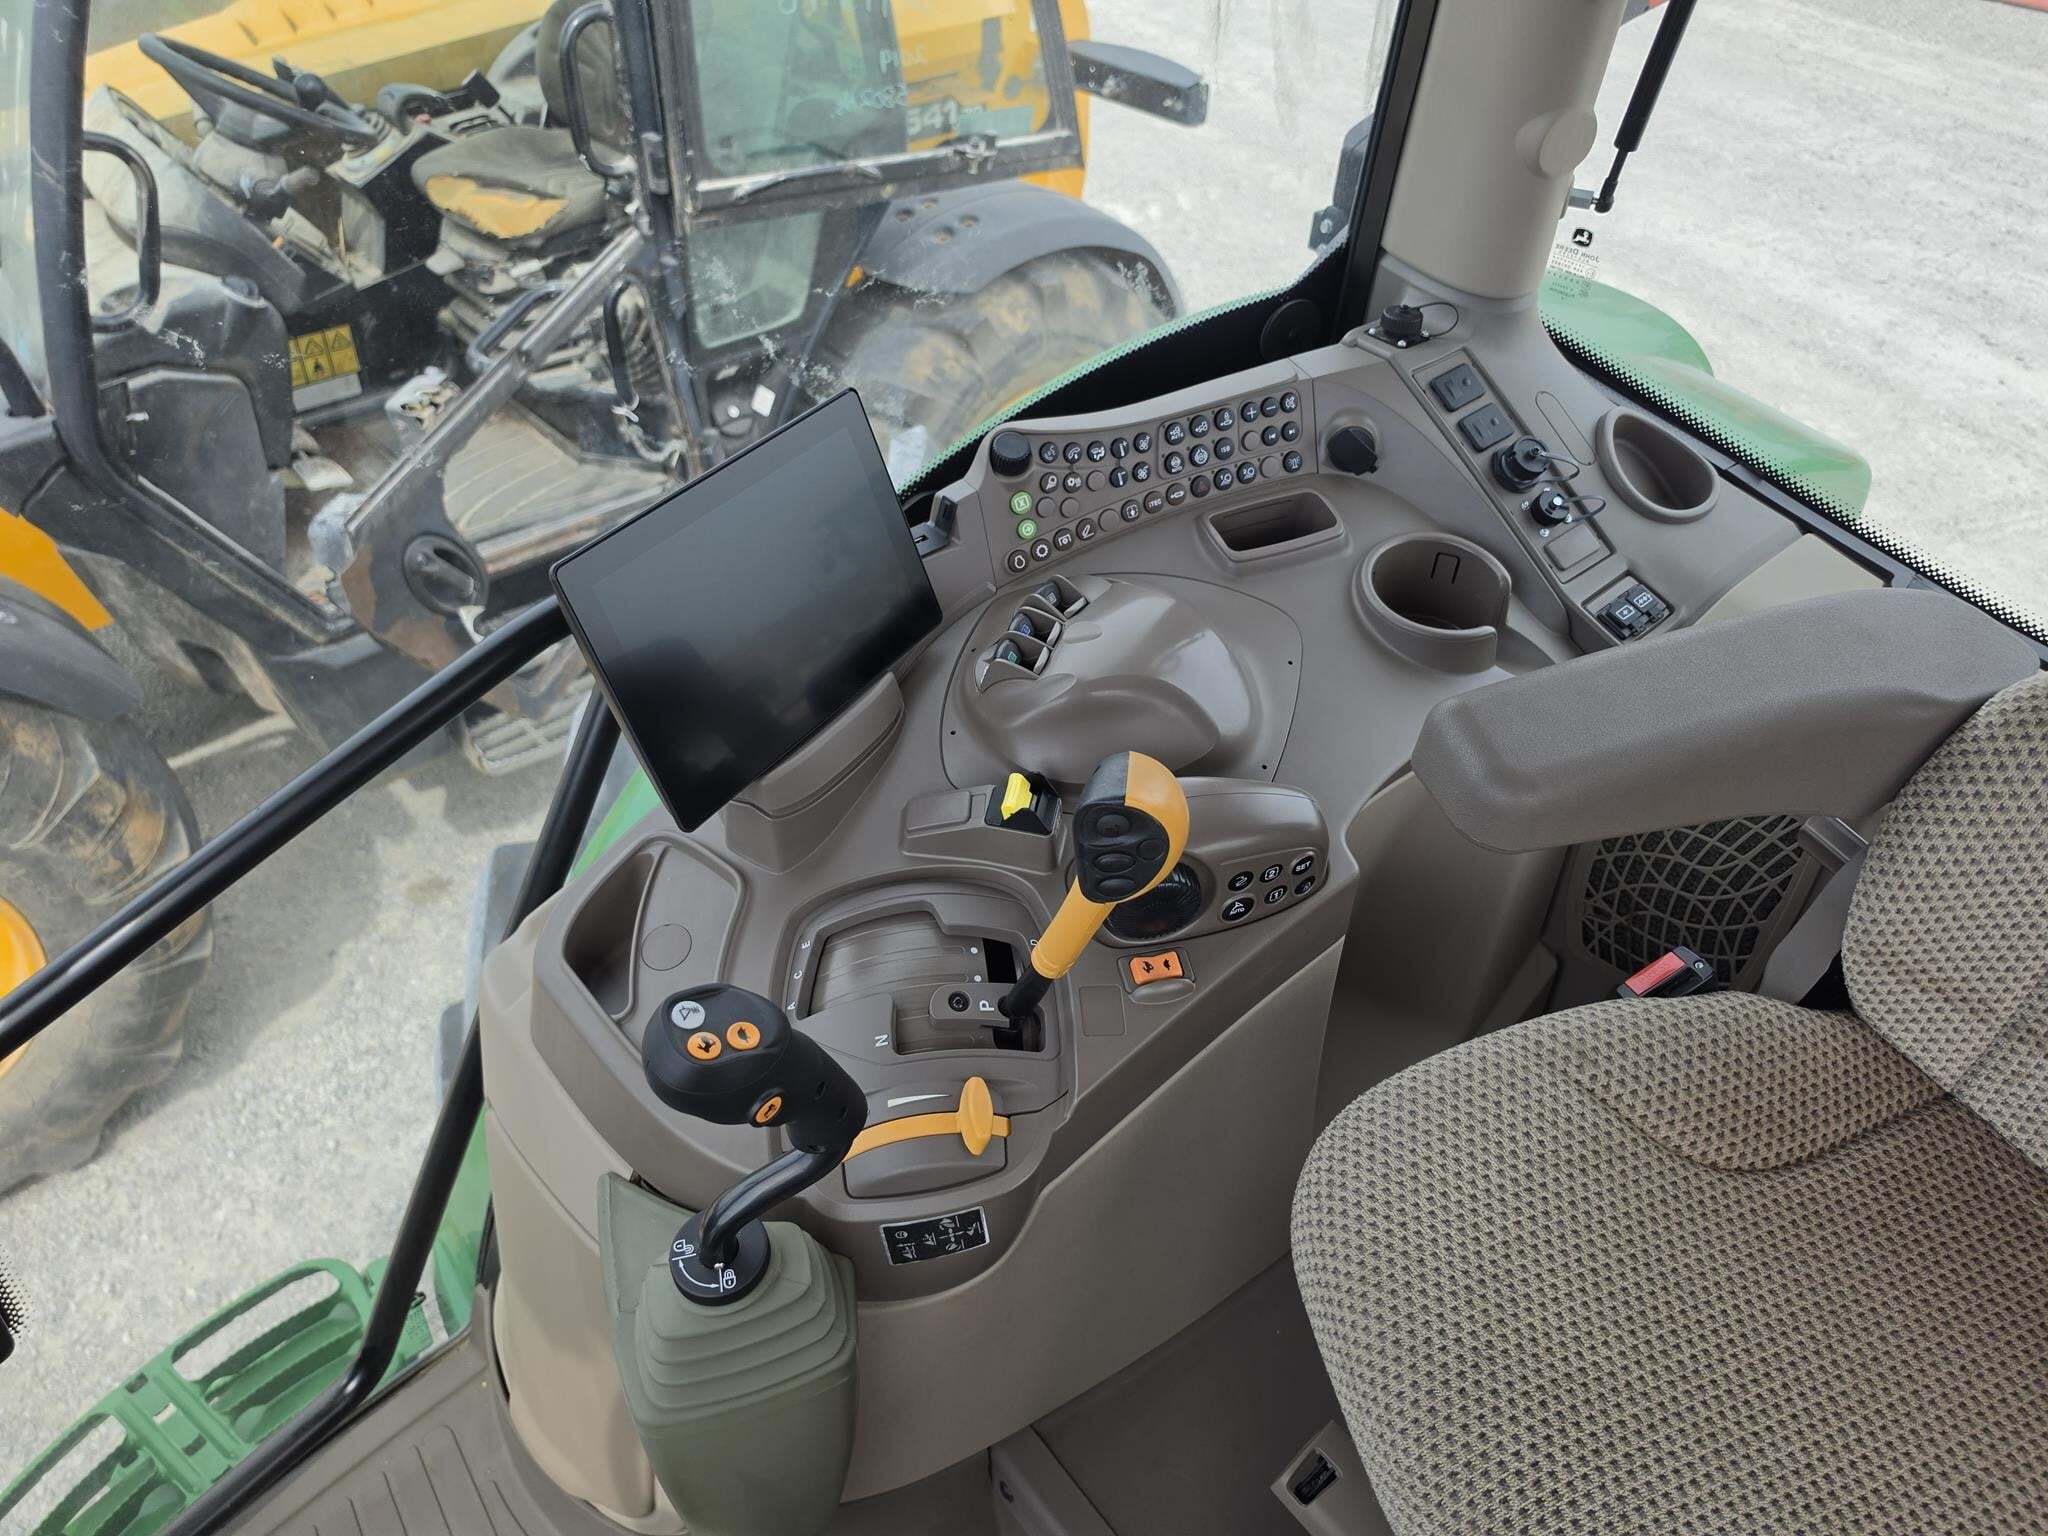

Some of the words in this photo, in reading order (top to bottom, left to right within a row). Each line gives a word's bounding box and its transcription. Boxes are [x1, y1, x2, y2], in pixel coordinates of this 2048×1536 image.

[1295, 861, 1312, 872] SET
[1268, 869, 1275, 877] 2
[1229, 907, 1245, 915] AUTO
[802, 940, 811, 949] E
[794, 970, 803, 980] C
[787, 1001, 796, 1010] A
[979, 1000, 995, 1012] P
[874, 1034, 889, 1047] N
